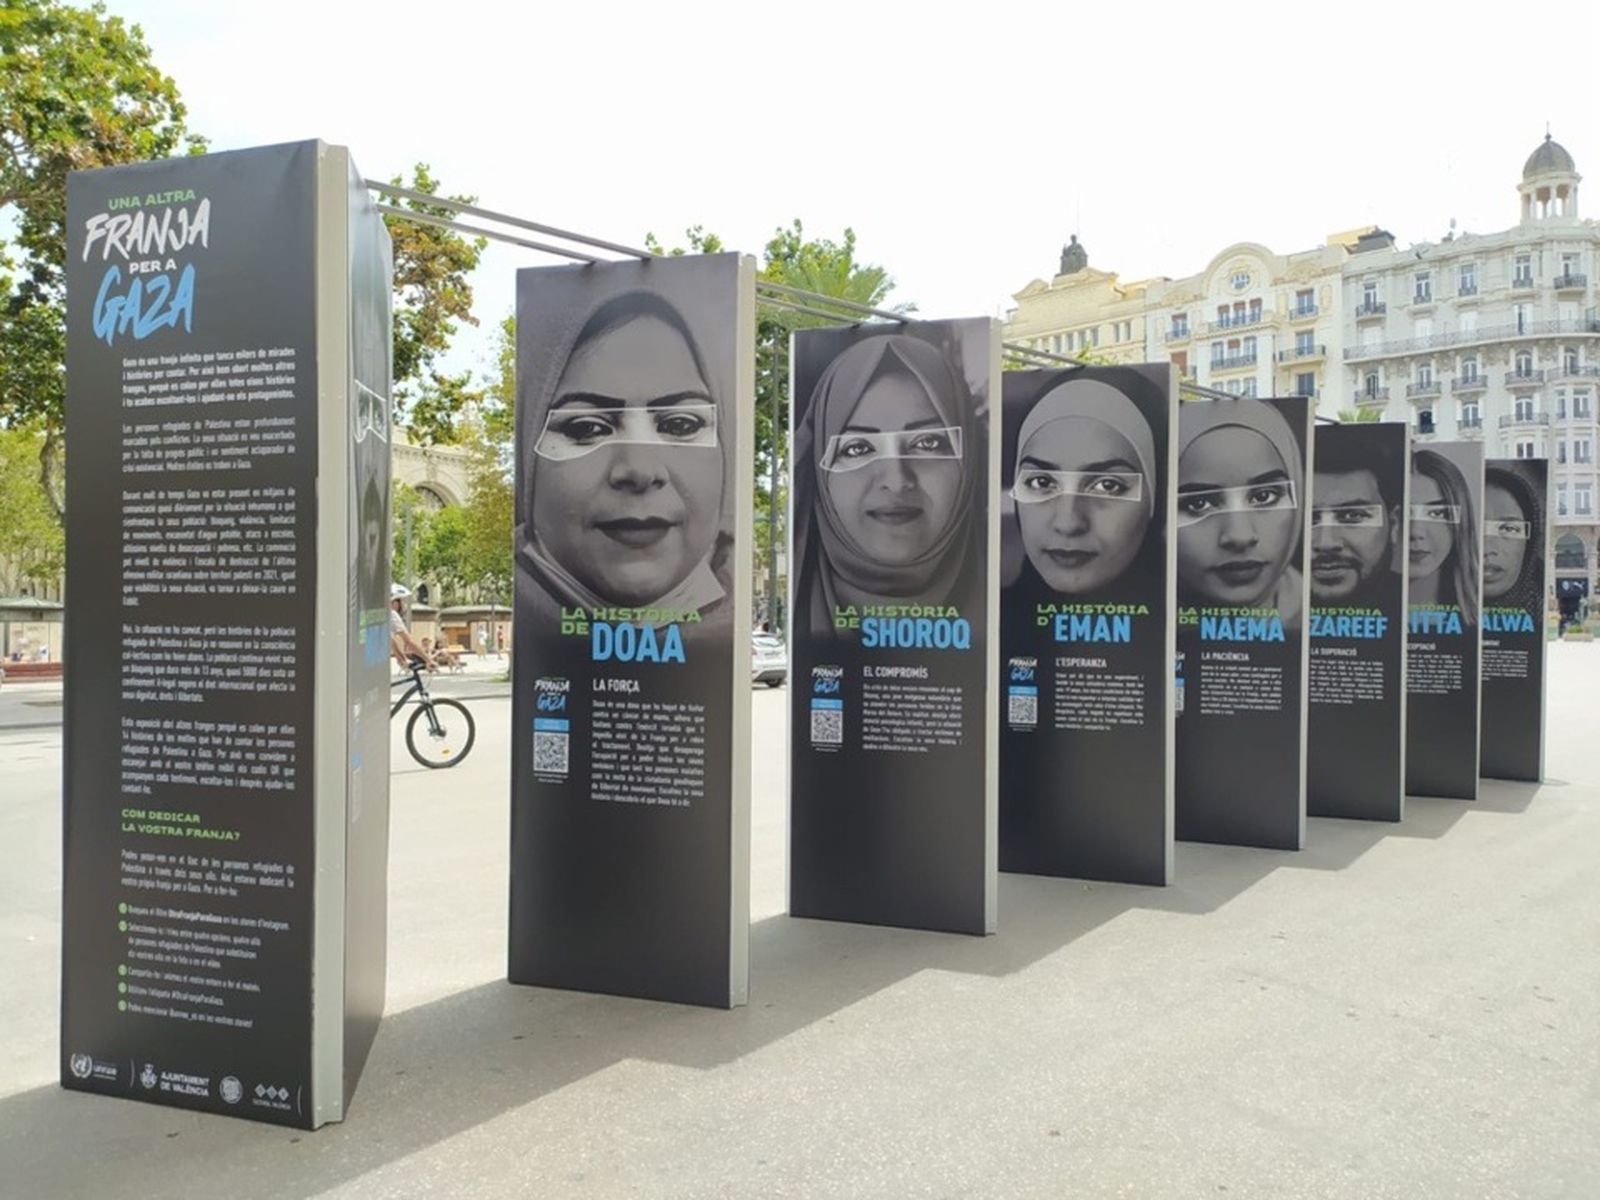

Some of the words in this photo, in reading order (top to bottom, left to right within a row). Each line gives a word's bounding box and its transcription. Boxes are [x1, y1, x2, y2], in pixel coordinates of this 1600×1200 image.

[108, 197, 141, 210] UNA
[145, 189, 196, 206] ALTRA
[82, 198, 211, 262] FRANJA
[129, 261, 163, 274] PER
[165, 258, 177, 271] A
[92, 263, 196, 347] GAZA
[561, 607, 587, 621] LA
[835, 605, 857, 615] LA
[863, 603, 959, 617] HISTÒRIA
[1036, 604, 1057, 613] LA
[1062, 602, 1149, 614] HISTÒRIA
[1178, 607, 1197, 616] LA
[1201, 606, 1281, 617] HISTÒRIA
[1178, 616, 1199, 625] DE
[1200, 616, 1285, 642] NAEMA
[1309, 615, 1388, 639] ZAREEF
[1407, 611, 1463, 635] ITTA
[835, 617, 860, 628] DE
[861, 618, 971, 650] SHOROQ
[561, 622, 588, 635] DE
[592, 622, 686, 663] DOAA
[1201, 652, 1211, 660] LA
[863, 666, 873, 677] EL
[875, 665, 929, 679] COMPROMÍS
[593, 678, 606, 691] LA
[608, 679, 640, 694] FORÇA
[537, 694, 566, 711] GAZA
[122, 808, 146, 819] COM
[149, 811, 200, 824] DEDICAR
[122, 823, 136, 833] LA
[138, 825, 183, 837] VOSTRA
[186, 827, 241, 841] FRANJA?
[160, 1071, 210, 1086] AJUNTAMENT
[160, 1082, 171, 1091] DE
